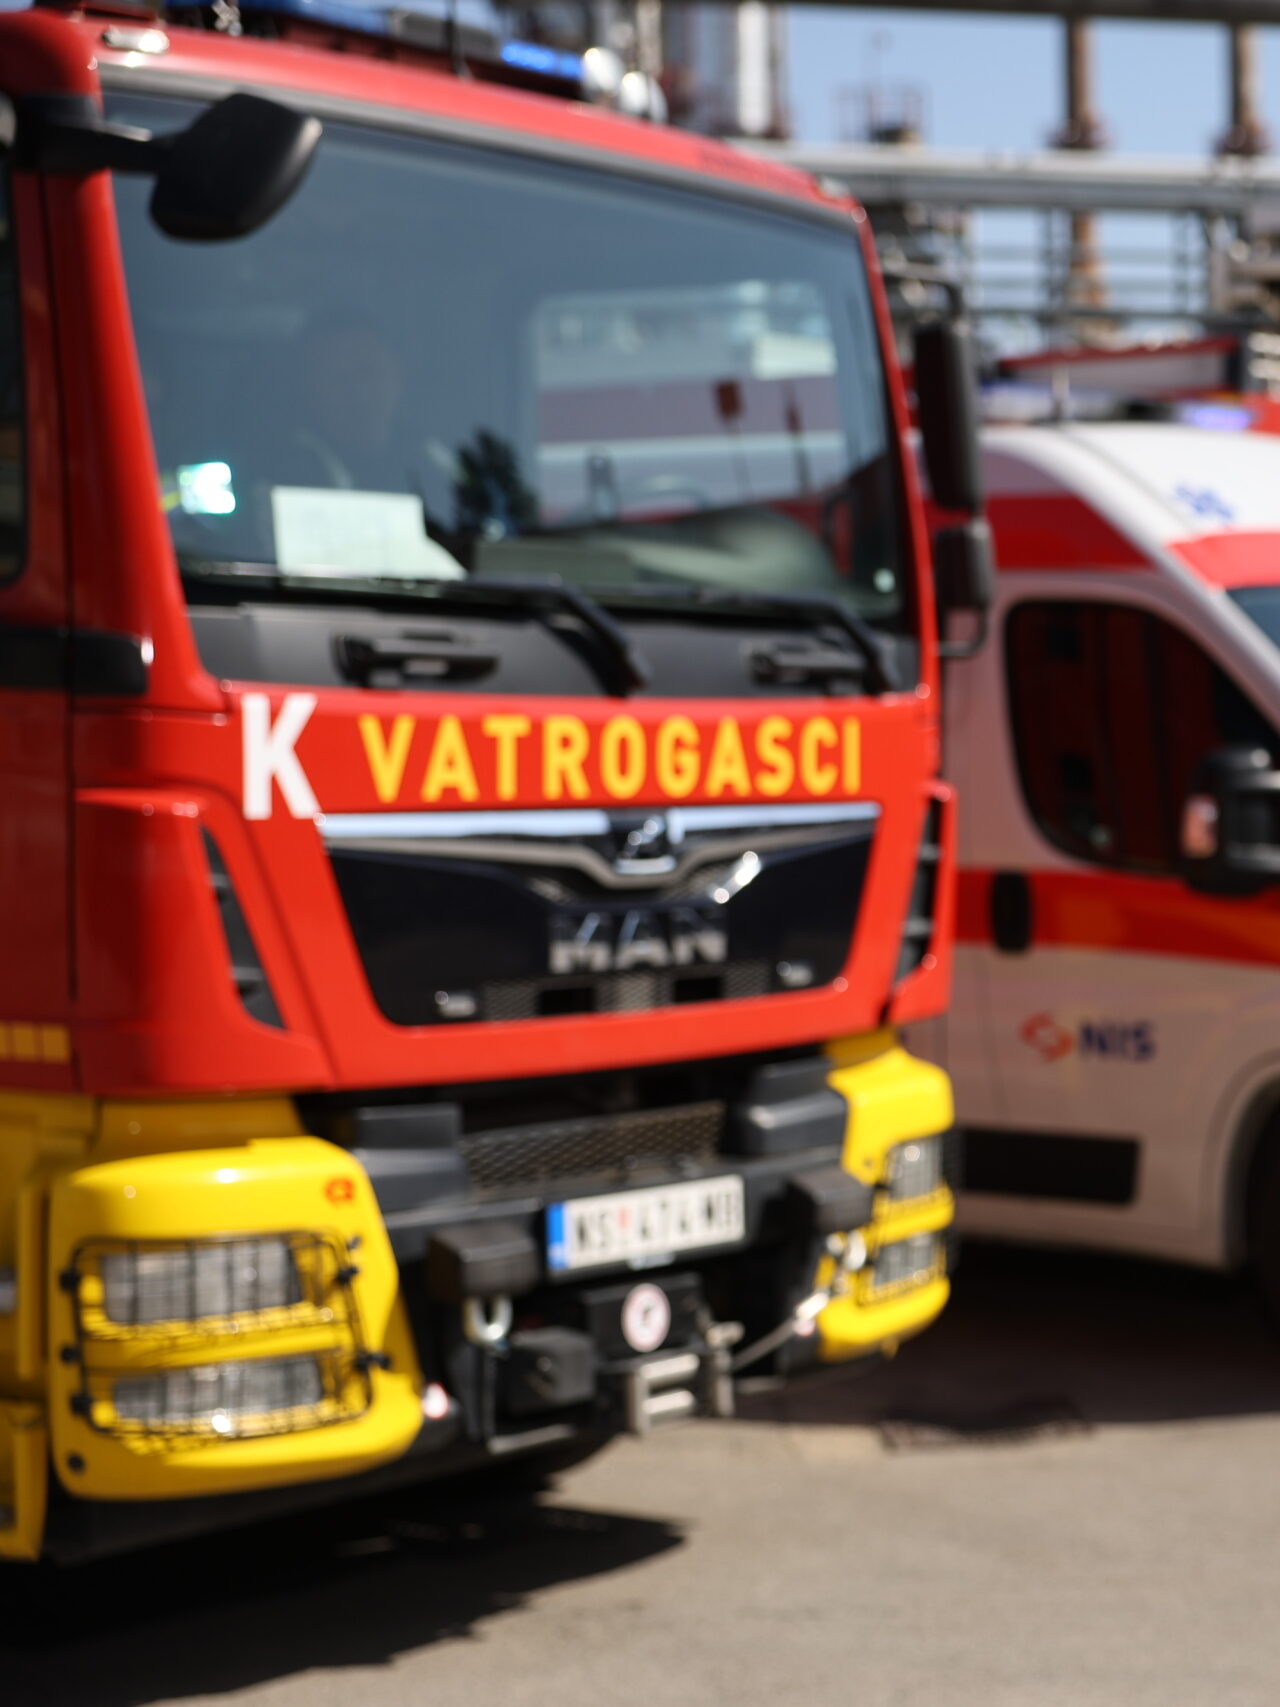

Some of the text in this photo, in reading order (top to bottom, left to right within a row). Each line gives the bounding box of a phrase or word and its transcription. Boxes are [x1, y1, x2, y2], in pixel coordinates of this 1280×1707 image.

[241, 692, 322, 820] K
[357, 712, 862, 803] VATROGASCI
[550, 911, 727, 975] MAN
[1079, 1018, 1157, 1062] NIS
